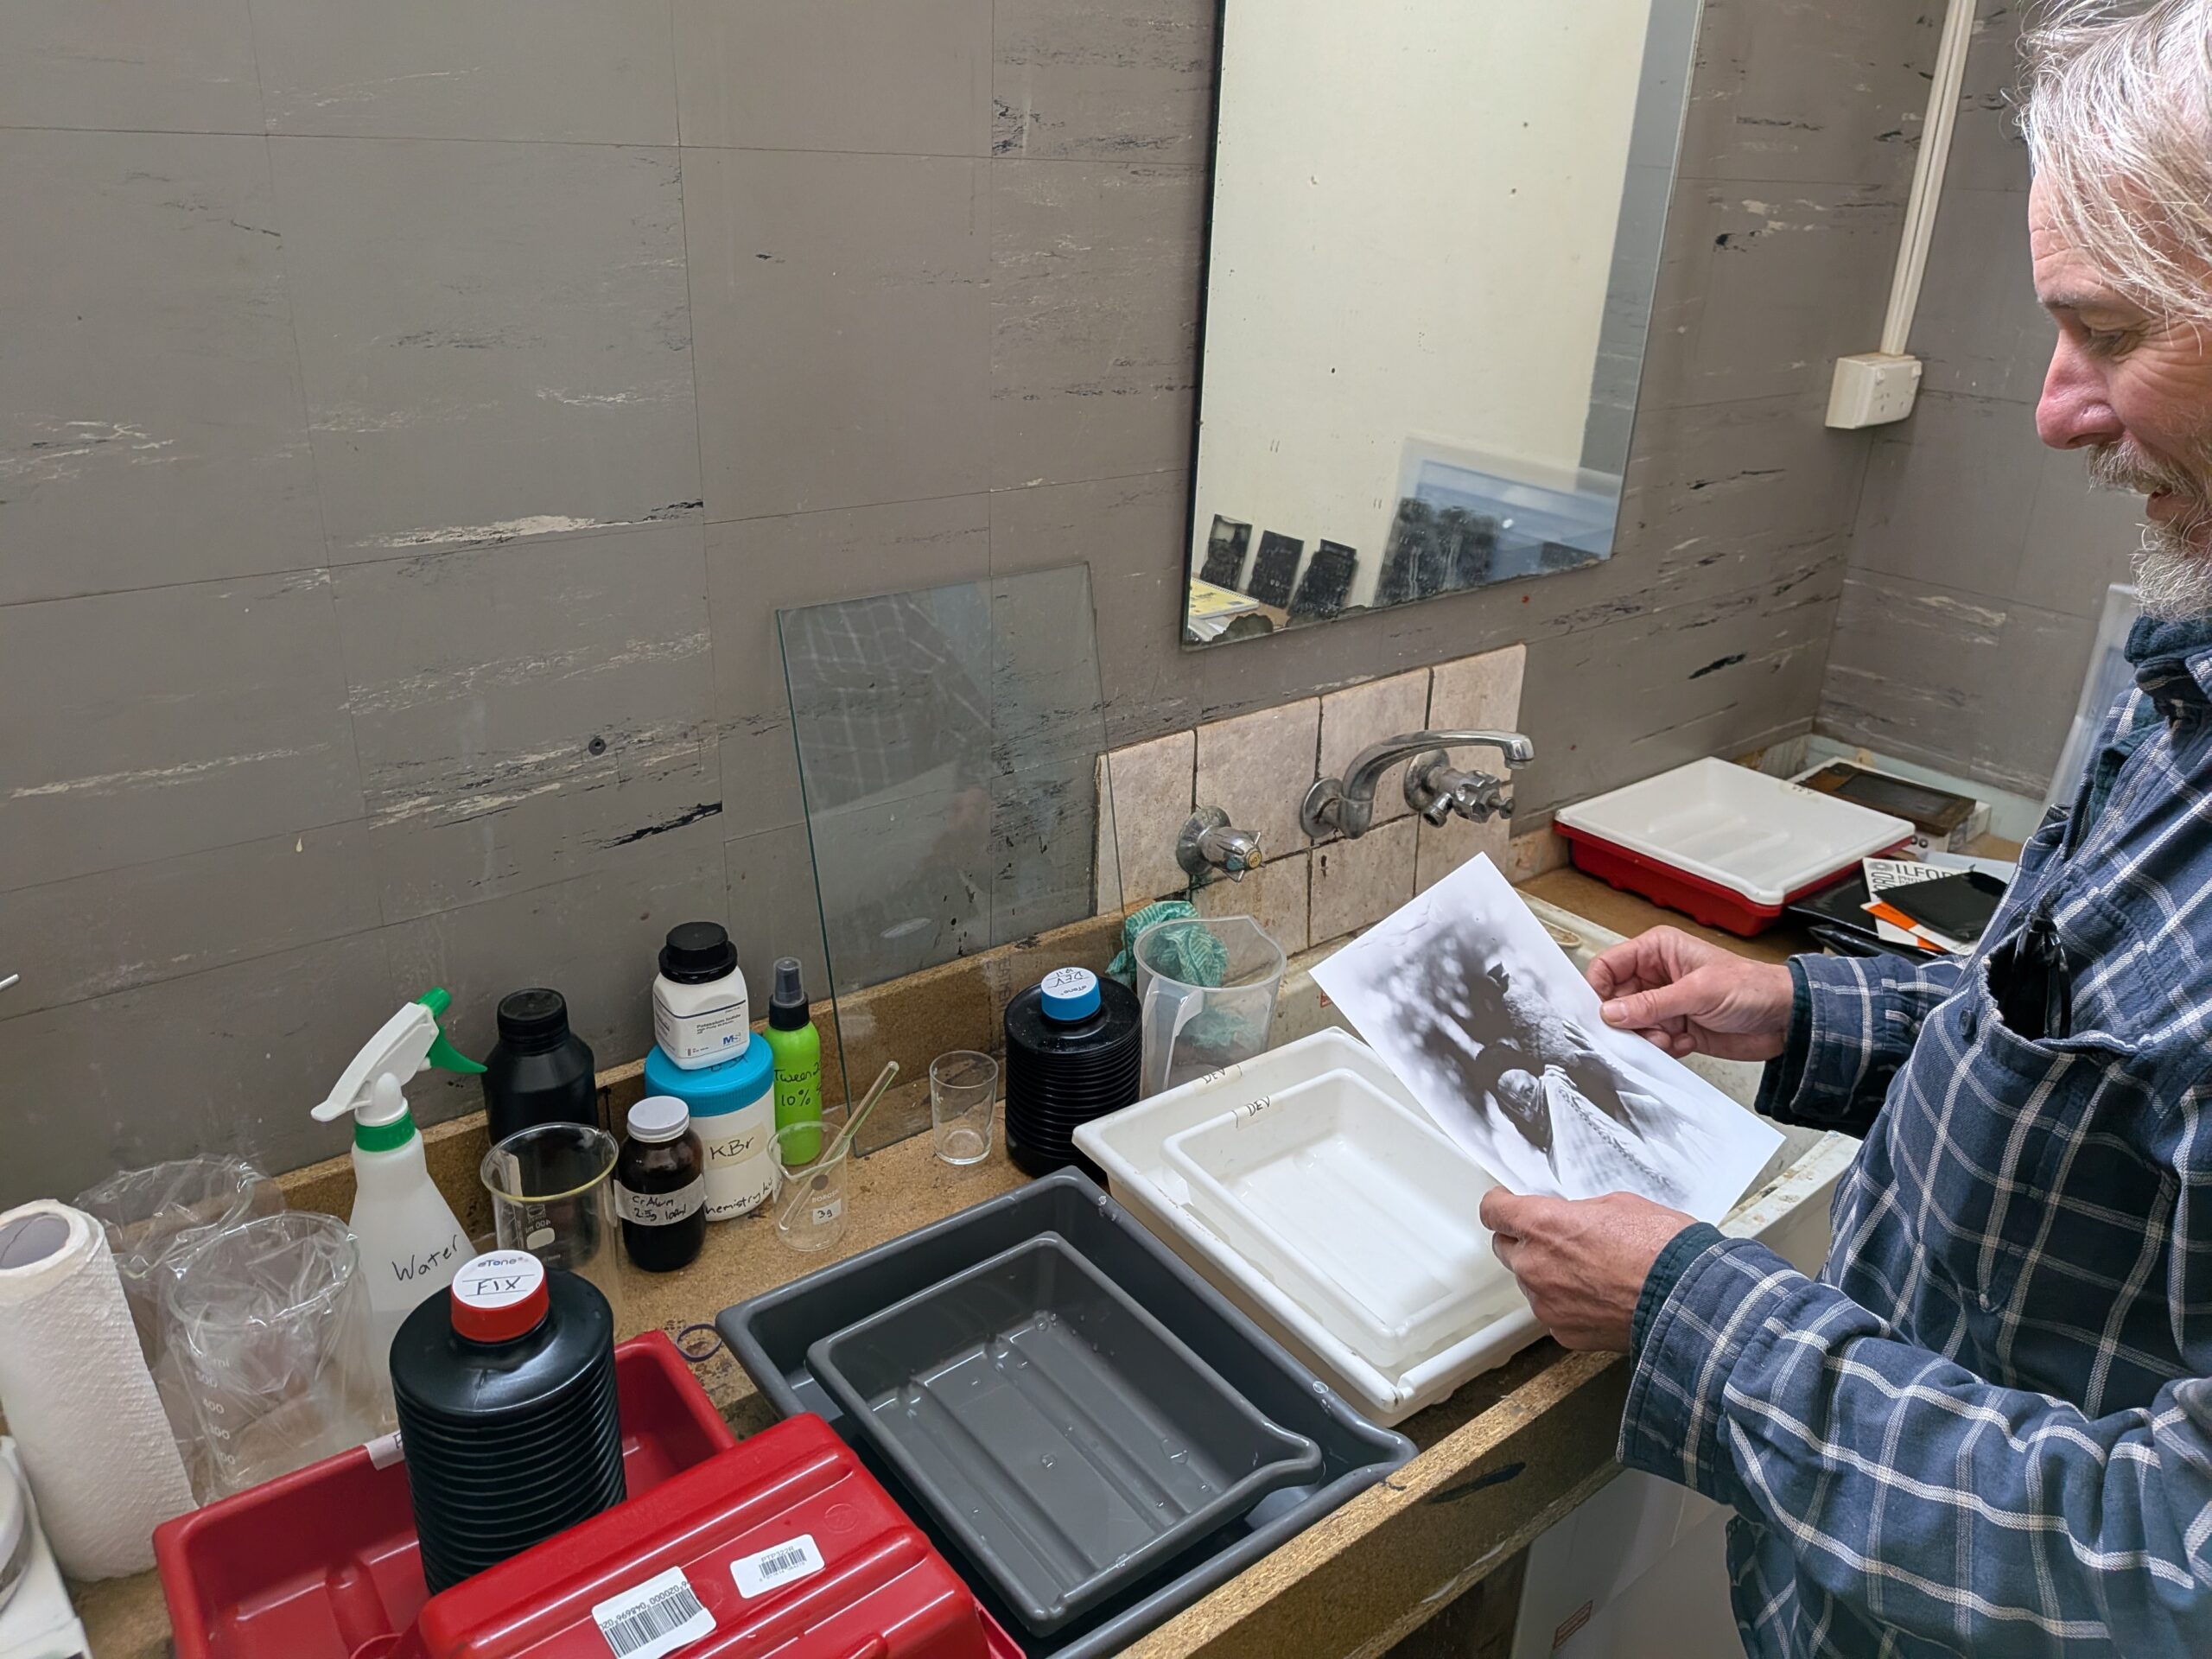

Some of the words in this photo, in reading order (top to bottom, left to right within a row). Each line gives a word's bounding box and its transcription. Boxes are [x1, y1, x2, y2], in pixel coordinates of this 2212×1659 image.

[1250, 854, 1261, 865] HOT
[1872, 872, 1896, 890] ORD
[1052, 971, 1084, 987] DEV
[696, 1020, 725, 1028] Potassium
[774, 1069, 812, 1083] Tween
[1202, 1068, 1226, 1084] DEV
[781, 1089, 810, 1107] 10%
[1245, 1096, 1270, 1116] DEV
[709, 1136, 754, 1160] KBr
[704, 1194, 761, 1215] hemistry
[391, 1234, 458, 1281] Water
[477, 1258, 517, 1268] eTone
[476, 1276, 521, 1296] FIX
[649, 1586, 680, 1605] 020000
[615, 1601, 647, 1620] 048696
